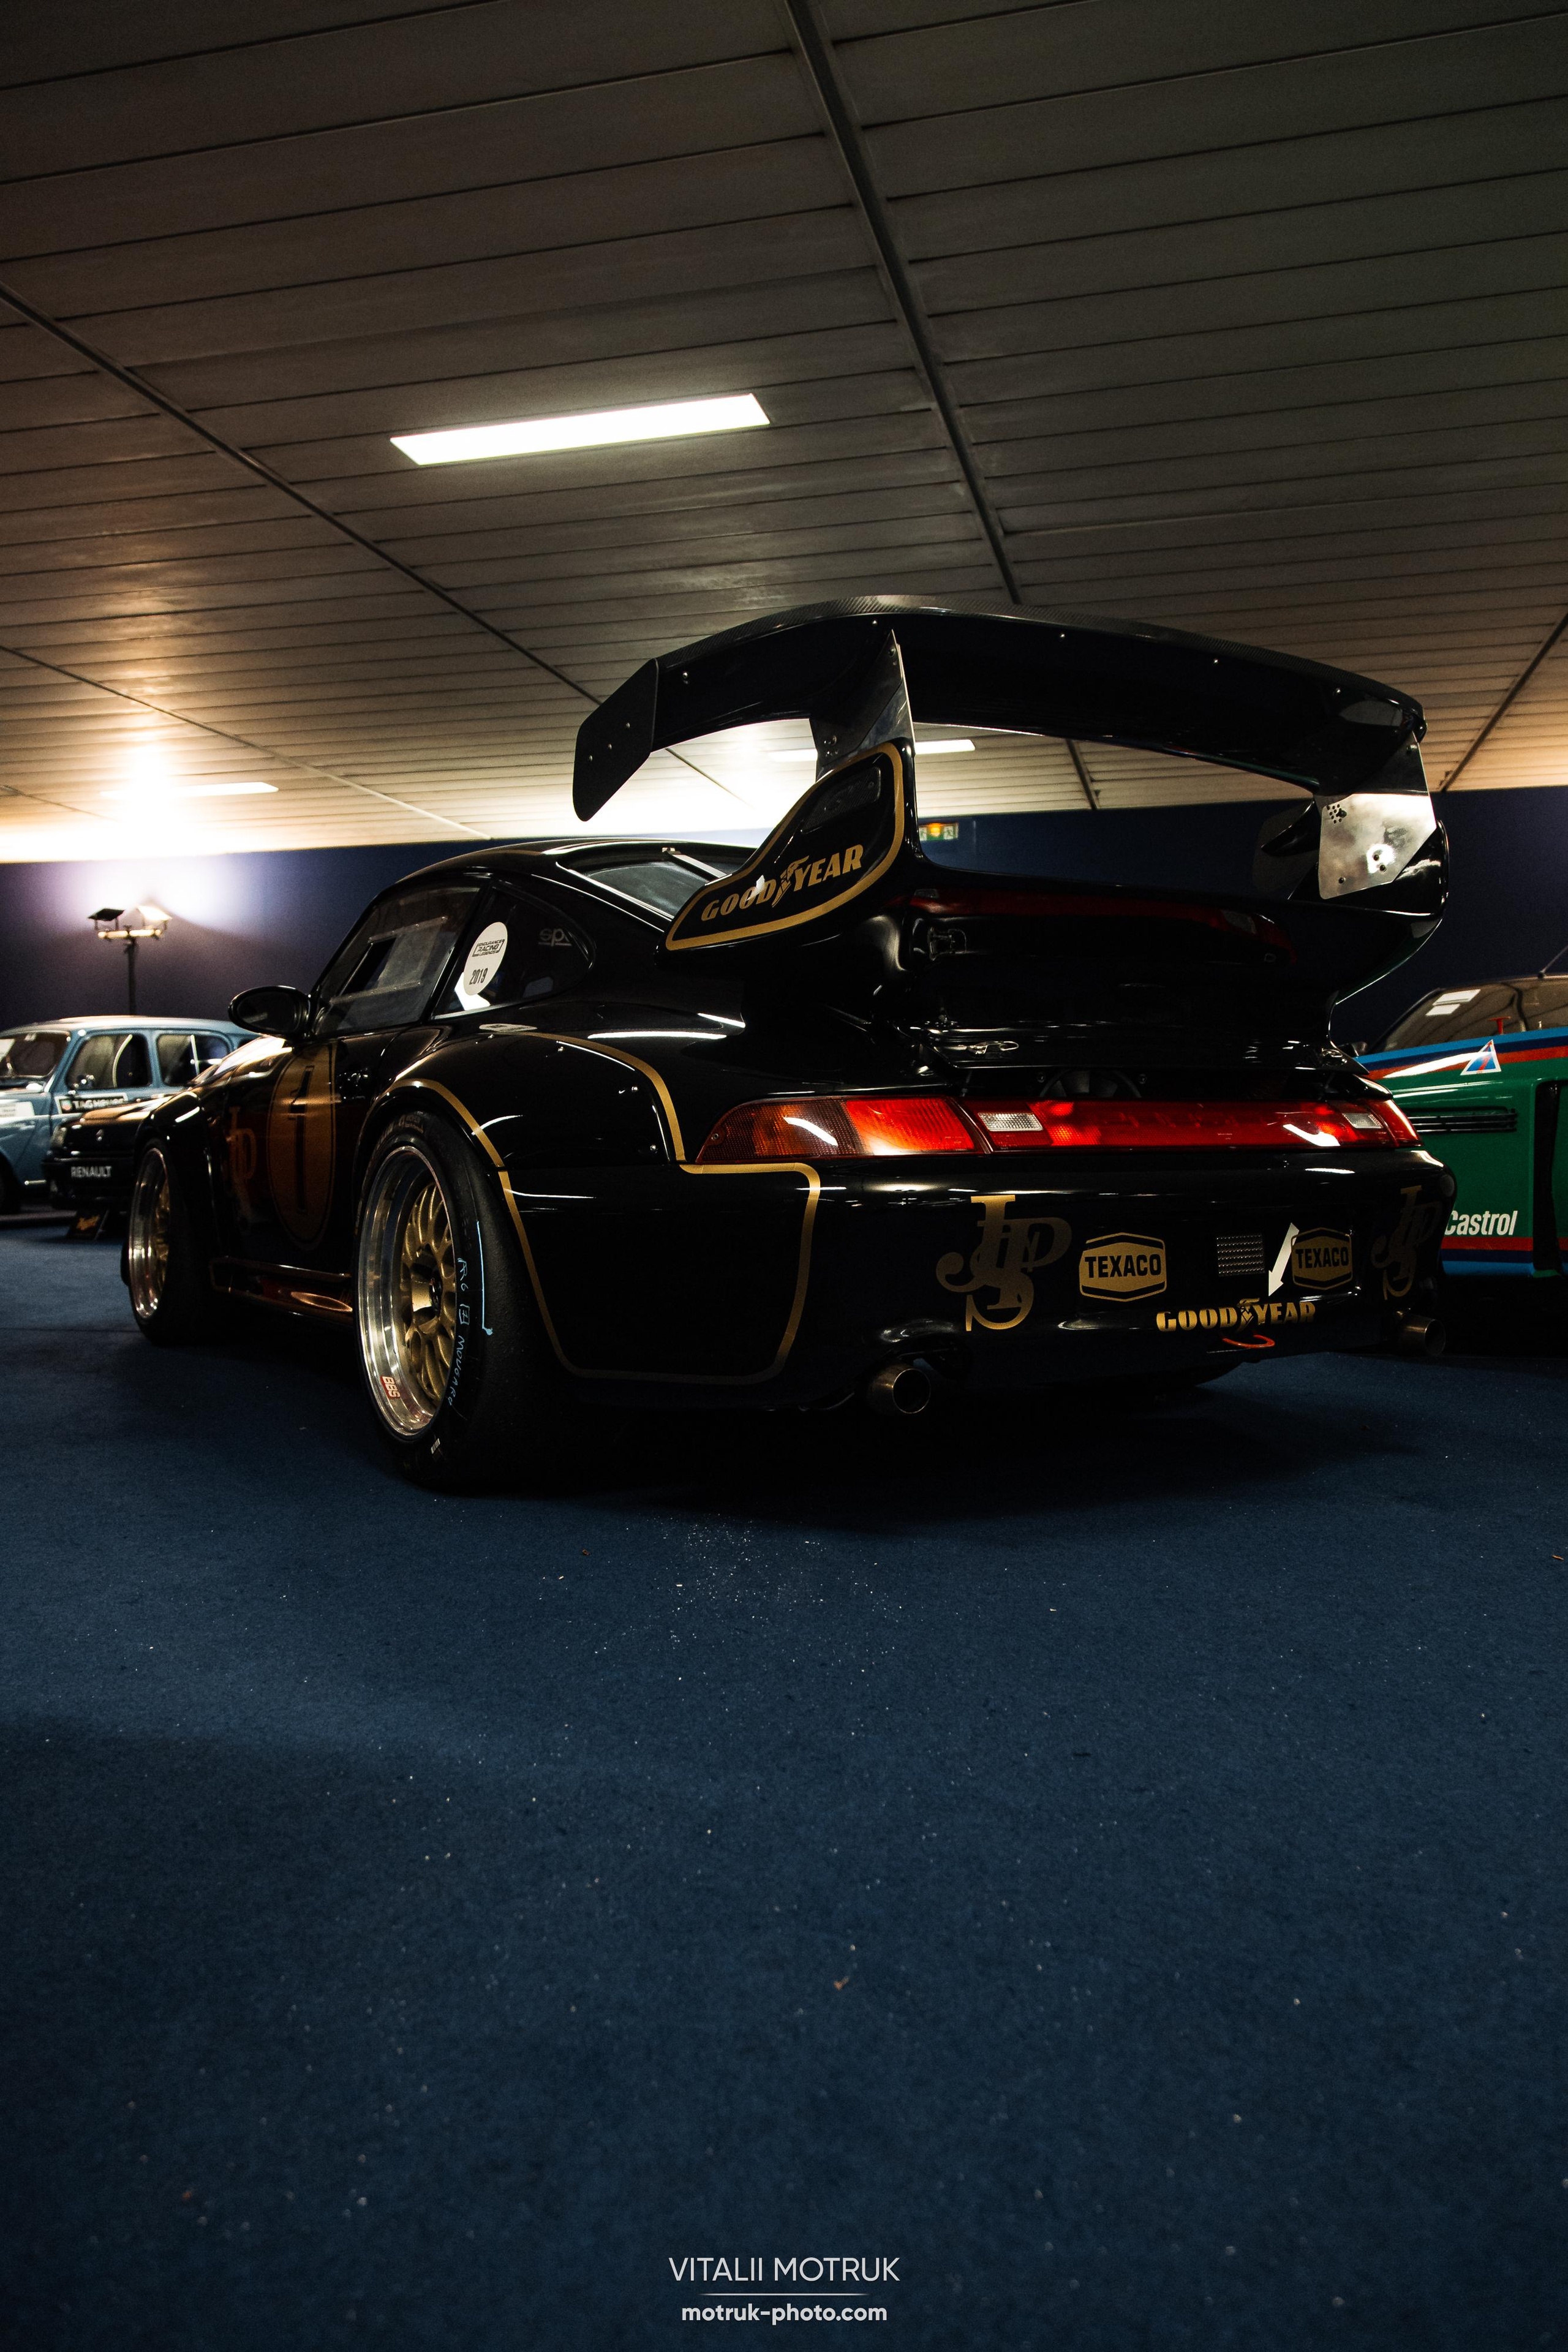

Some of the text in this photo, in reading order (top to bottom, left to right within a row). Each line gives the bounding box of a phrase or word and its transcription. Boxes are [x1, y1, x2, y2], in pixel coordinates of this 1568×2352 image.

[701, 844, 864, 921] GOODYEAR
[469, 968, 488, 985] 2019
[70, 1166, 111, 1177] RENAULT
[1444, 1210, 1518, 1235] Castrol
[1085, 1254, 1161, 1278] TEXACO
[1295, 1246, 1349, 1269] TEXACO
[1156, 1299, 1316, 1332] GOODYEAR
[382, 1376, 401, 1397] BBS
